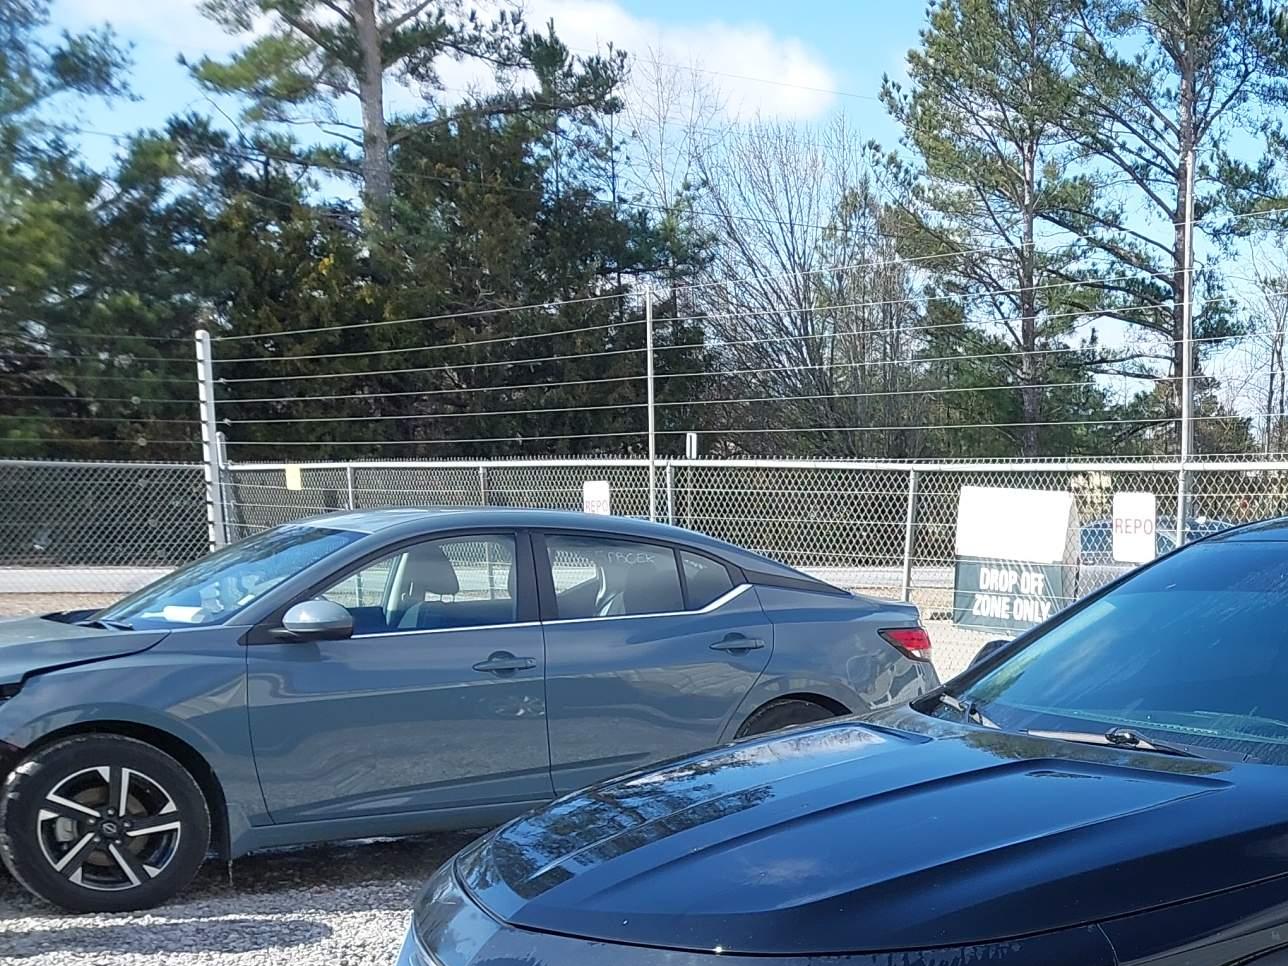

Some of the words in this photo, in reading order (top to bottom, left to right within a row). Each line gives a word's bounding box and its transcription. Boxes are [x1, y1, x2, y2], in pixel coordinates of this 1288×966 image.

[585, 499, 609, 513] REPO
[1115, 517, 1154, 536] REPO
[980, 567, 1019, 593] DROP
[1020, 571, 1045, 595] OFF
[972, 593, 1011, 619] ZONE
[1013, 597, 1052, 624] ONLY
